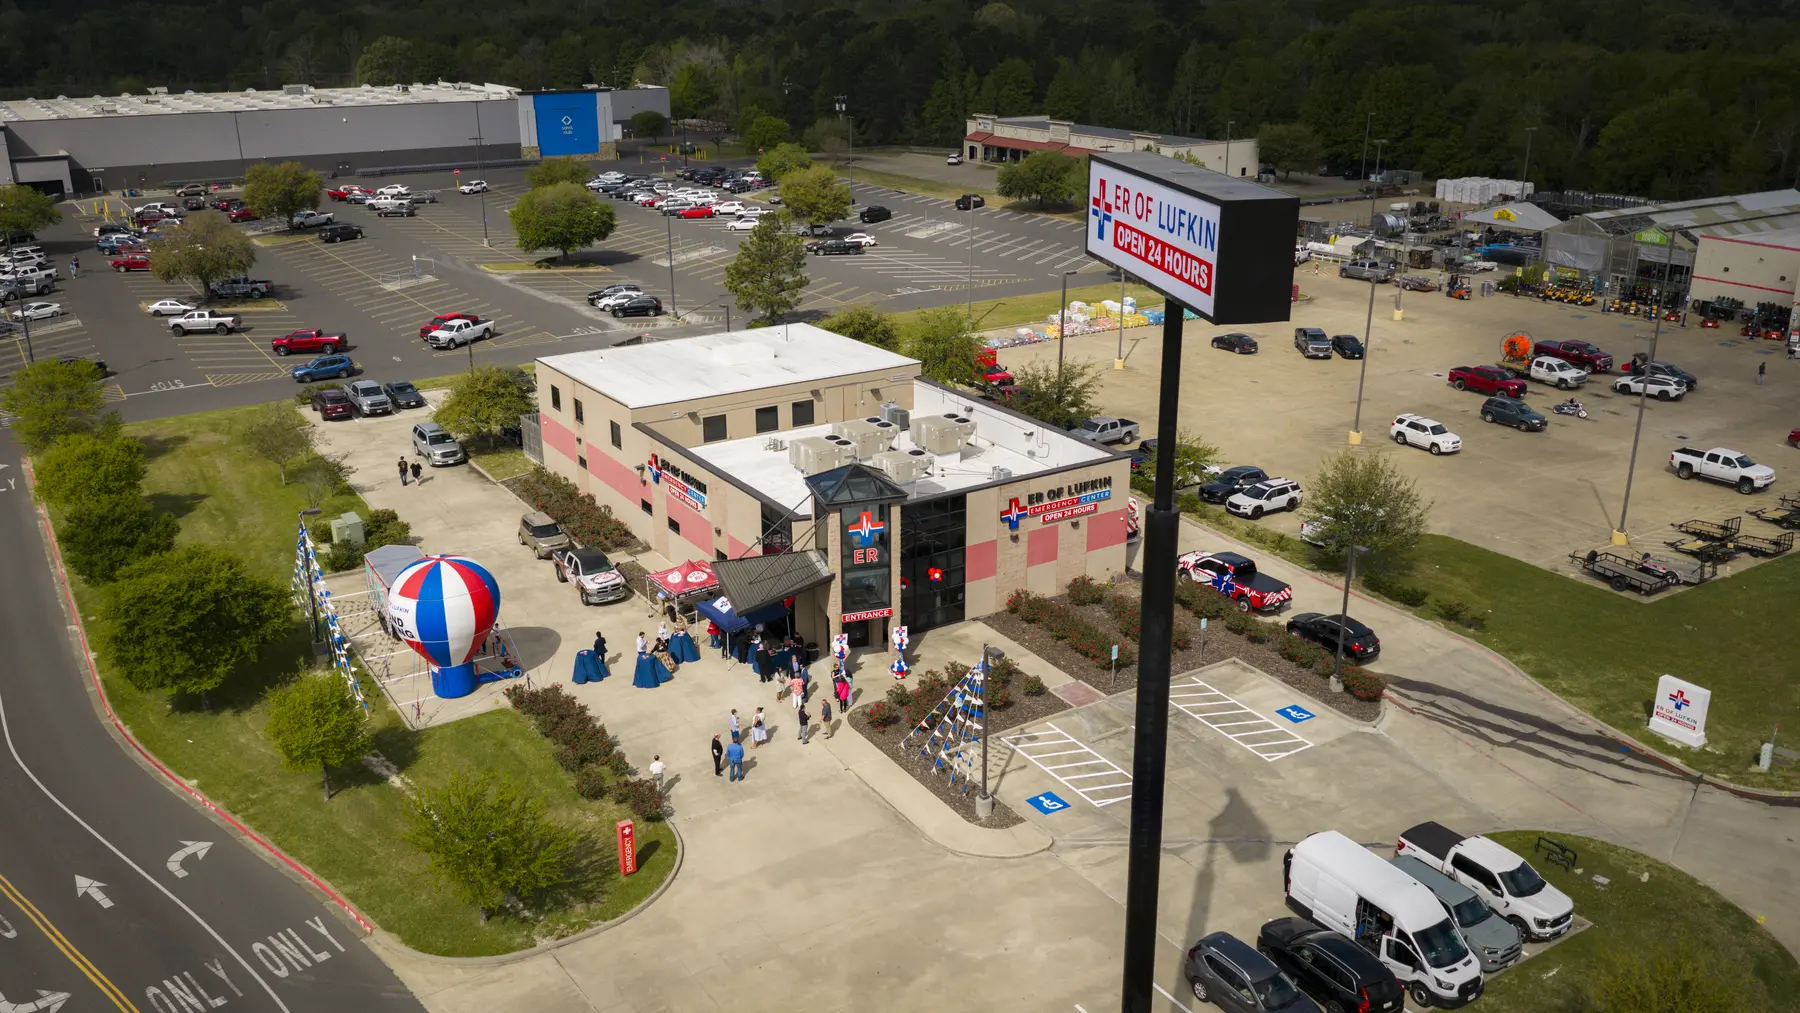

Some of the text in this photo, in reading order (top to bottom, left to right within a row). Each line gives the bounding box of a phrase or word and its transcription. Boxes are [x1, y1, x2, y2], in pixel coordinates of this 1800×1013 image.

[1114, 184, 1216, 252] ER OF LUFKIN
[1117, 225, 1208, 289] OPEN 24 HOURS
[150, 379, 184, 391] STOP
[1028, 476, 1112, 505] ER OF LUFKIN
[1030, 491, 1110, 514] EMERGENCY CENTER
[1044, 504, 1095, 522] OPEN 24 HOURS
[854, 548, 878, 565] ER
[845, 609, 889, 622] ENTRANCE
[1656, 704, 1664, 712] ER
[1675, 712, 1698, 725] LUFKIN
[624, 838, 633, 872] EMERGENCY
[251, 916, 346, 978] ONLY
[145, 958, 244, 1013] ONLY
